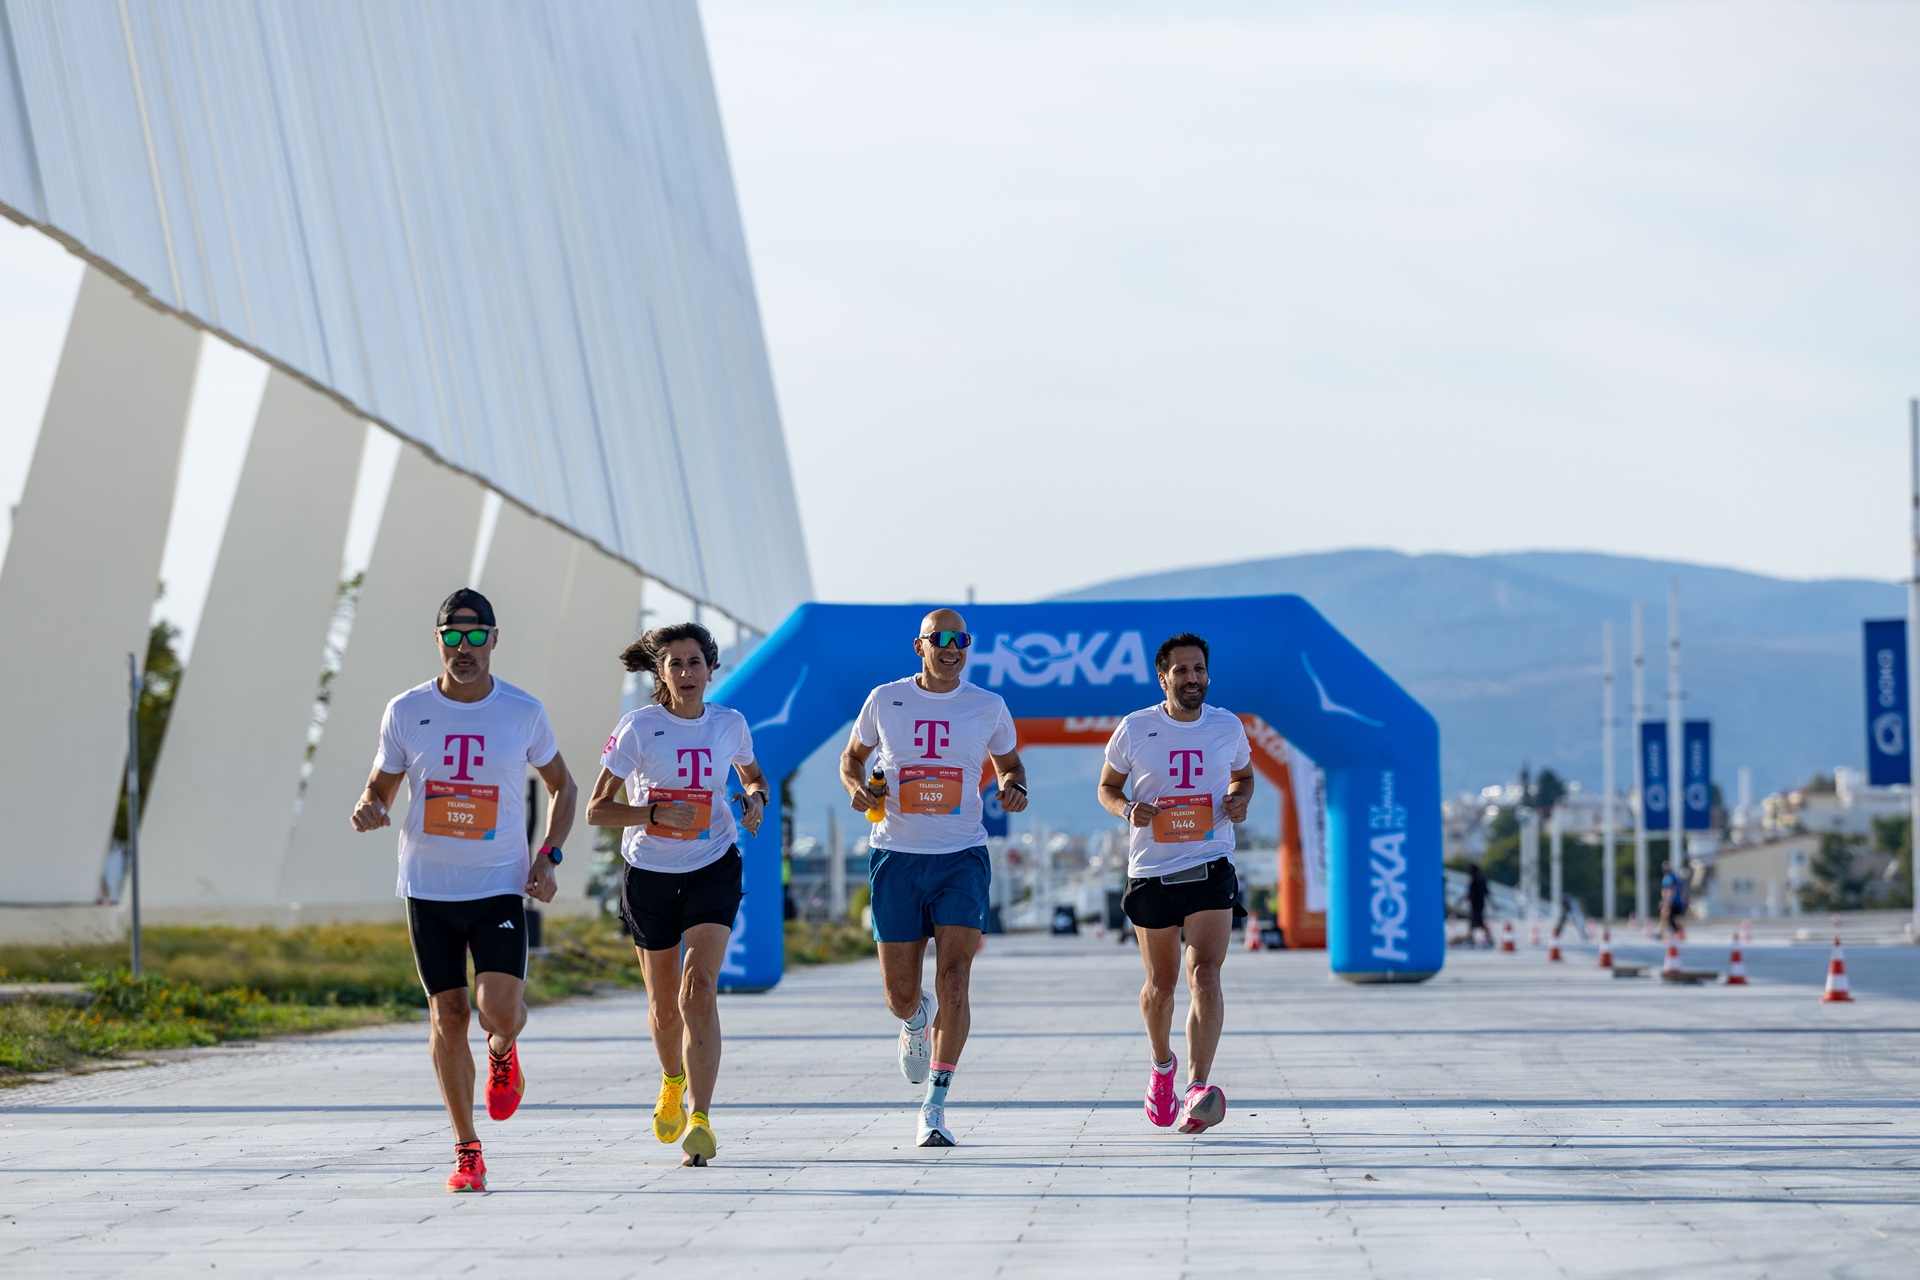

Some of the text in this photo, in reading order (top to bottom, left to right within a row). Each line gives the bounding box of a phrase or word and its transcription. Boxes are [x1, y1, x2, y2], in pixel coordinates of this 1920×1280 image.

[963, 631, 1150, 687] HOKA
[919, 792, 943, 802] 1439
[447, 801, 476, 809] TELEKOM
[447, 811, 474, 824] 1392
[1171, 819, 1196, 829] 1446
[1370, 831, 1408, 962] HOKA
